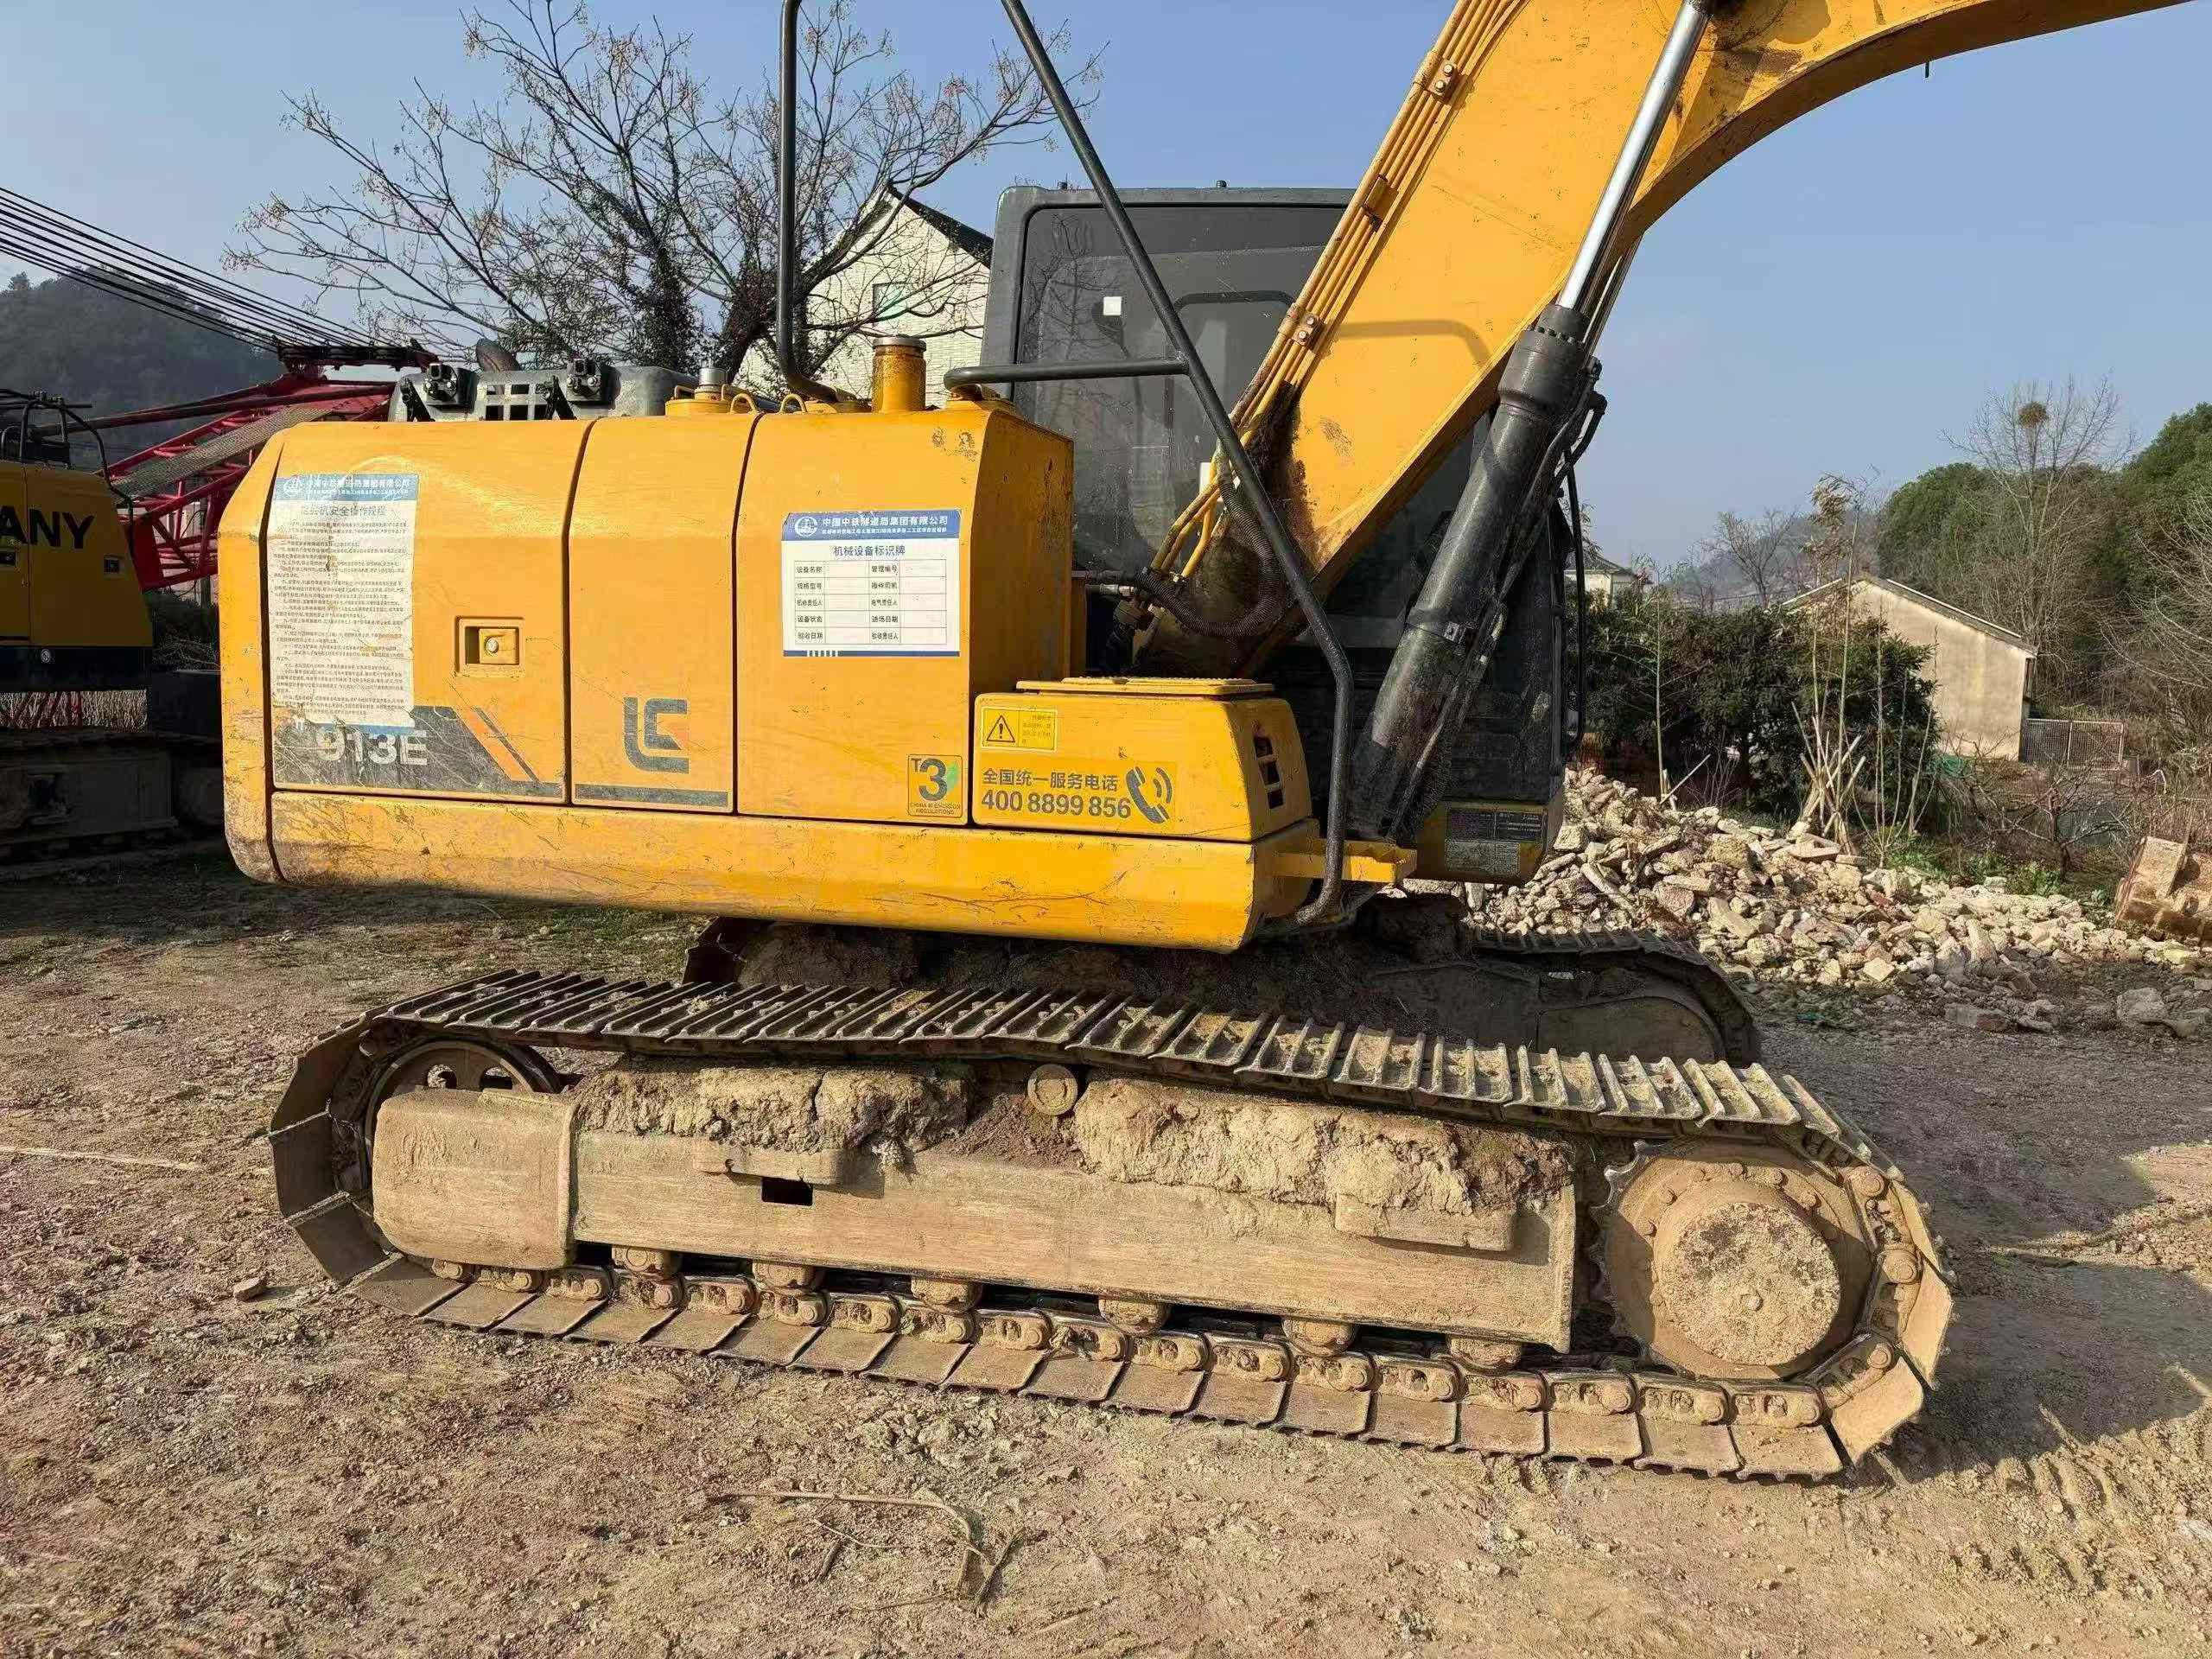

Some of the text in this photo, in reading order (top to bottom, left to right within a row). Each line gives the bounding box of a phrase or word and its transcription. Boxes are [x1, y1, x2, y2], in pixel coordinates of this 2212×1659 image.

[834, 545, 906, 557] 机械设备标识牌
[317, 726, 428, 766] 913E
[982, 768, 1119, 792] 全国统一服务电话
[981, 789, 1131, 819] 400 8899 856
